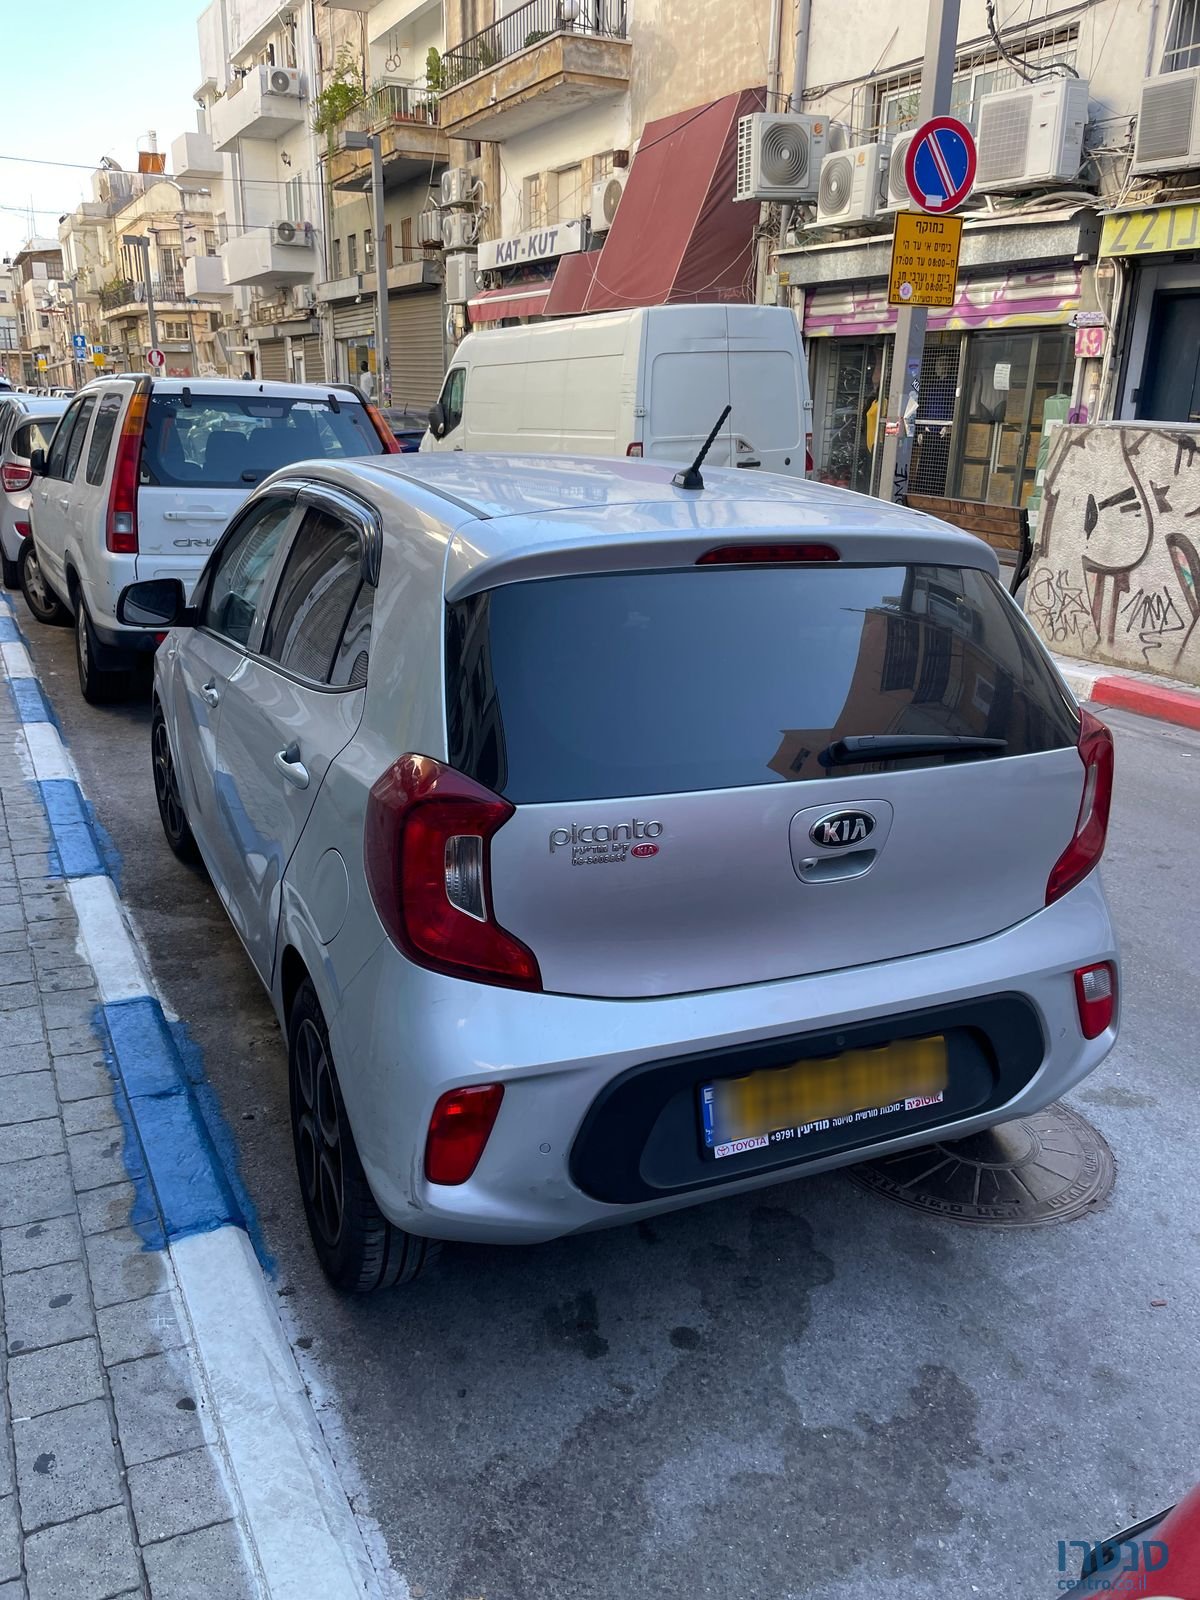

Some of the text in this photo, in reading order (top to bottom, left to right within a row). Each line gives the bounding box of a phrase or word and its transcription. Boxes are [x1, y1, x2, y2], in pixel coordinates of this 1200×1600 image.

[915, 221, 944, 234] בתוקף
[912, 240, 921, 250] עד
[934, 242, 952, 253] בימים
[895, 255, 913, 265] 17:00
[917, 256, 925, 266] עד
[897, 271, 906, 280] חג
[910, 271, 928, 281] וערבי
[937, 273, 950, 283] ביום
[914, 281, 923, 290] עד
[823, 818, 867, 843] KIA
[549, 818, 663, 854] picanto
[797, 1119, 830, 1138] מודיעין
[731, 1137, 767, 1152] TOYOTA
